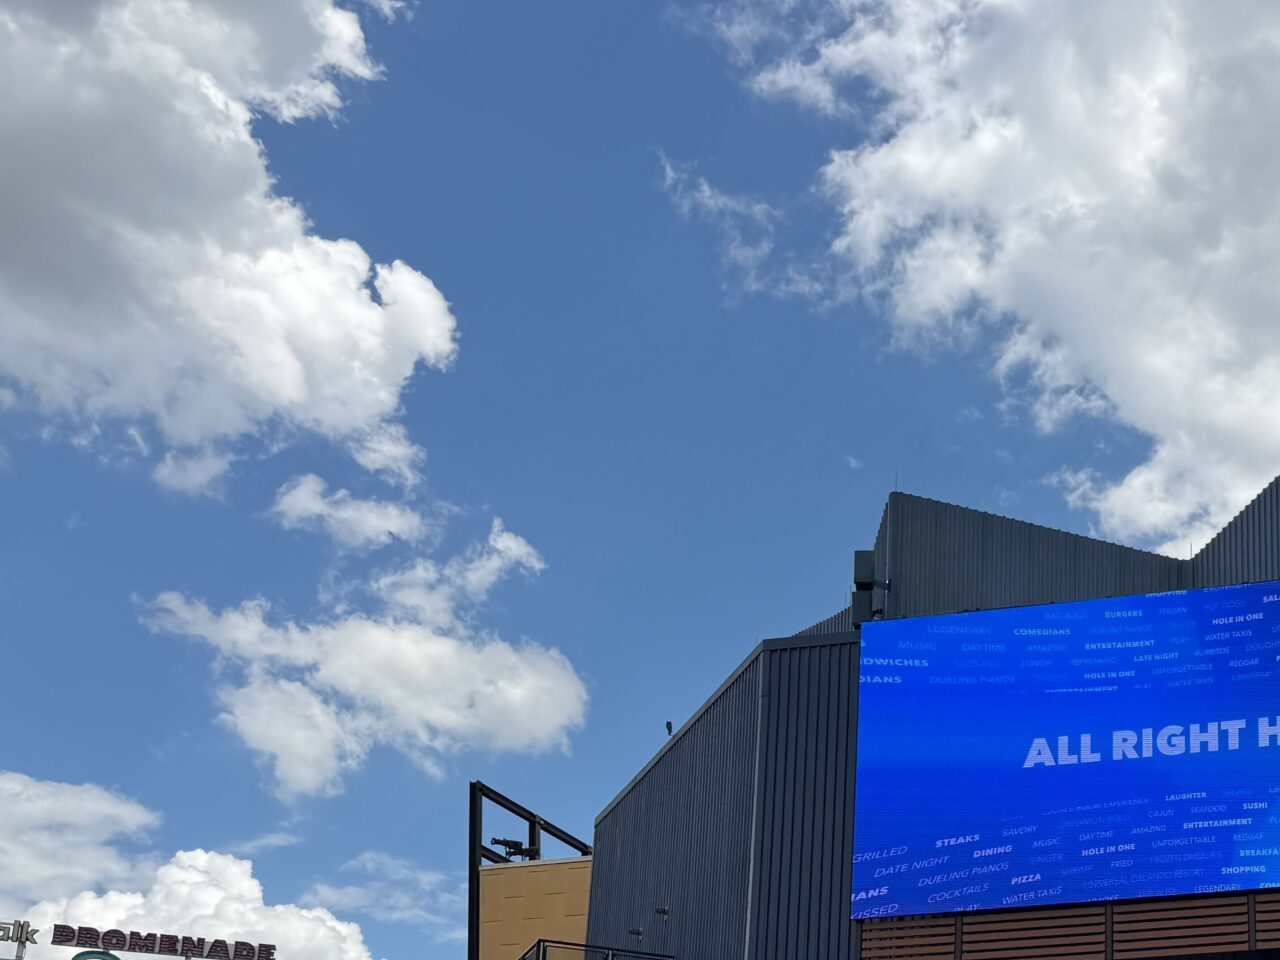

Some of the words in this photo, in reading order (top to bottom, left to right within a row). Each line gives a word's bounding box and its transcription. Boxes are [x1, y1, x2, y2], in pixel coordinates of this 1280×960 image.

[1104, 609, 1144, 619] BURGERS
[1212, 616, 1234, 626] HOLE
[1235, 614, 1244, 624] IN
[1245, 612, 1264, 623] ONE
[1013, 627, 1072, 635] COMEDIANS
[1205, 632, 1230, 641] WATER
[1232, 629, 1253, 638] TAXIS
[898, 641, 937, 650] MUSIC
[961, 643, 1006, 652] DAYTIME
[1084, 640, 1155, 650] ENTERTAINMENT
[1133, 654, 1153, 662] LATE
[1155, 652, 1180, 660] NIGHT
[1229, 658, 1261, 668] REGGAE
[1083, 672, 1107, 680] HOLE
[1108, 671, 1117, 679] IN
[1118, 669, 1136, 678] ONE
[1151, 662, 1214, 675] UNFORGETTABLE
[1022, 734, 1100, 769] ALL
[1112, 719, 1247, 761] RIGHT
[1165, 791, 1208, 801] LAUGHTER
[1243, 801, 1269, 809] SUSHI
[1147, 808, 1176, 818] CAJUN
[1183, 817, 1253, 829] ENTERTAINMENT
[1001, 824, 1039, 837] SAVORY
[1131, 824, 1167, 835] AMAZING
[935, 834, 980, 848] STEAKS
[1032, 836, 1061, 848] MUSIC
[1080, 831, 1114, 842] DAYTIME
[1152, 836, 1216, 849] UNFORGETTABLE
[851, 845, 908, 864] GRILLED
[973, 844, 1013, 858] DINING
[1082, 847, 1106, 857] HOLE
[1107, 845, 1117, 855] IN
[1118, 843, 1136, 853] ONE
[874, 863, 910, 877] DATE
[911, 856, 950, 871] NIGHT
[1111, 860, 1134, 869] FRIED
[1221, 864, 1267, 875] SHOPPING
[918, 868, 970, 887] DUELING
[970, 861, 1010, 877] PIANOS
[1011, 873, 1043, 885] PIZZA
[928, 882, 990, 903] COCKTAILS
[1194, 882, 1242, 894] LEGENDARY
[1002, 890, 1036, 905] WATER
[1037, 886, 1063, 898] TAXIS
